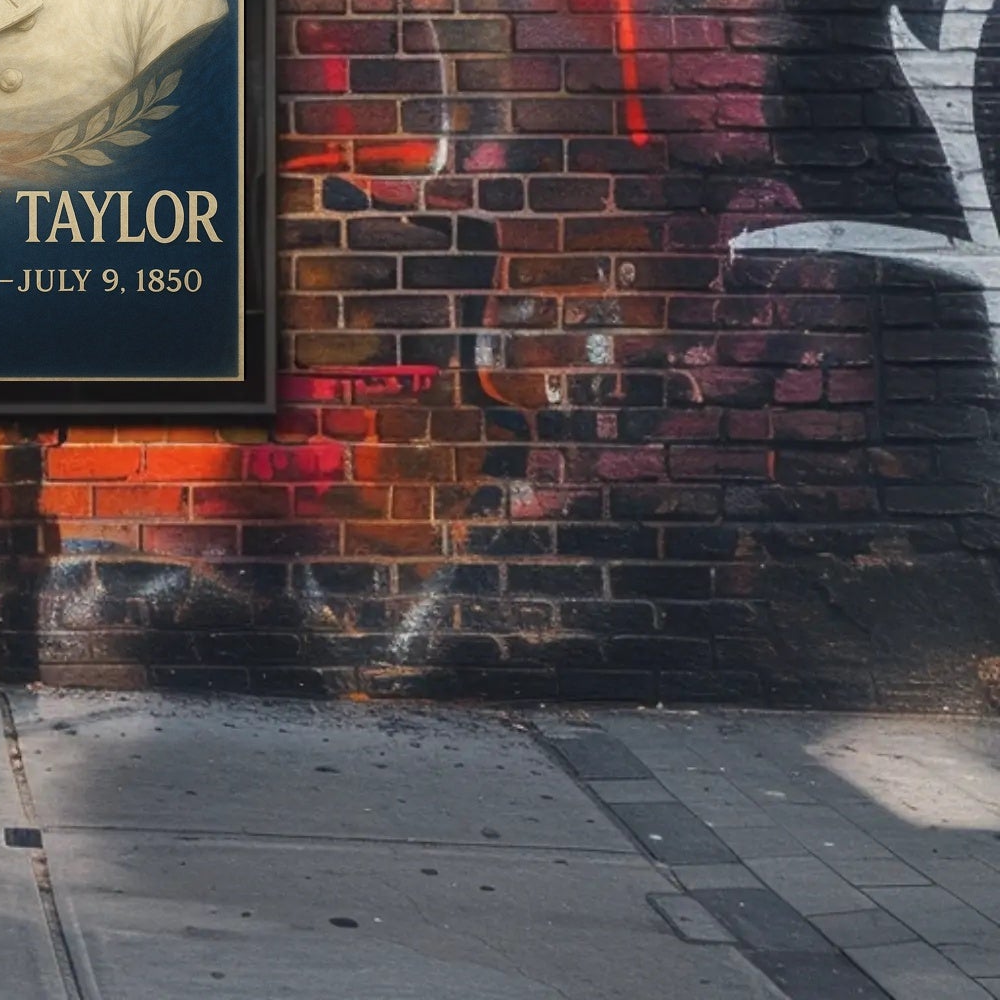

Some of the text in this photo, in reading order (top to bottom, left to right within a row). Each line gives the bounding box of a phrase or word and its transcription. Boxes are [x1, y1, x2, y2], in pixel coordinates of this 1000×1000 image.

[15, 190, 223, 243] TAYLOR
[102, 269, 126, 295] 9,
[136, 269, 202, 293] 1850
